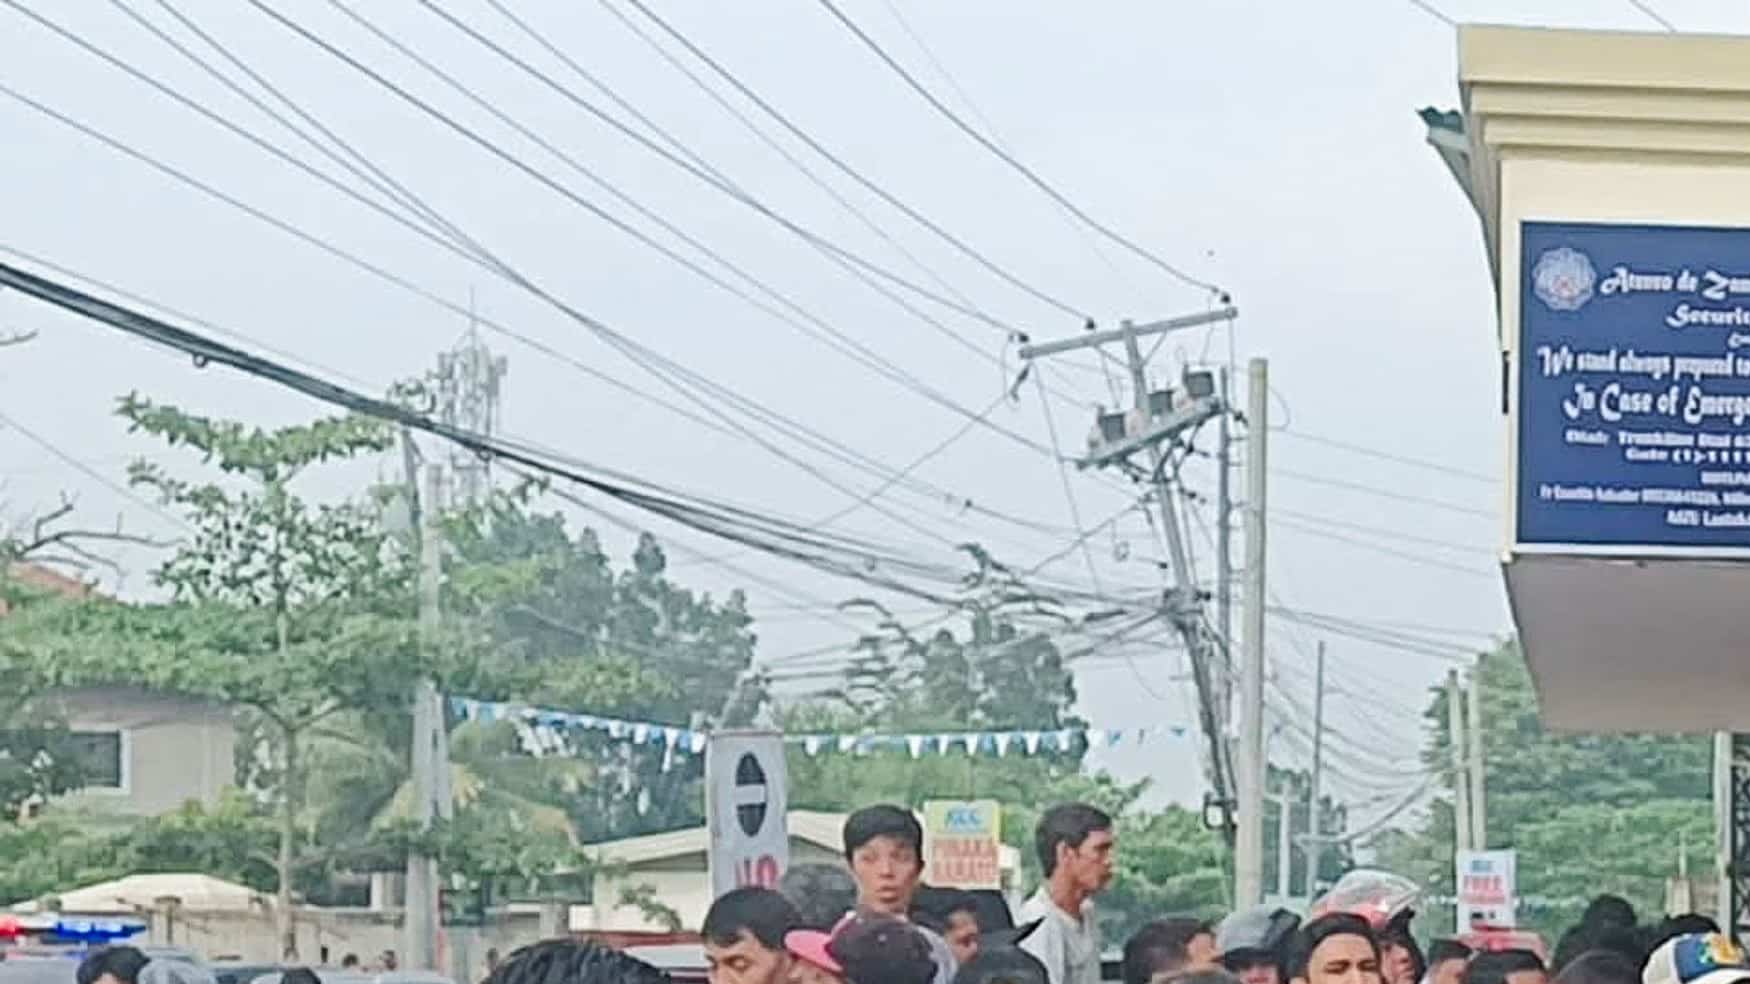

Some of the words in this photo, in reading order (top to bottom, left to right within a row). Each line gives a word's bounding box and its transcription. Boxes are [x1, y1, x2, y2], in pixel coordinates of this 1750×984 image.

[1677, 268, 1697, 292] de
[1600, 383, 1652, 421] Case
[1657, 385, 1679, 415] of
